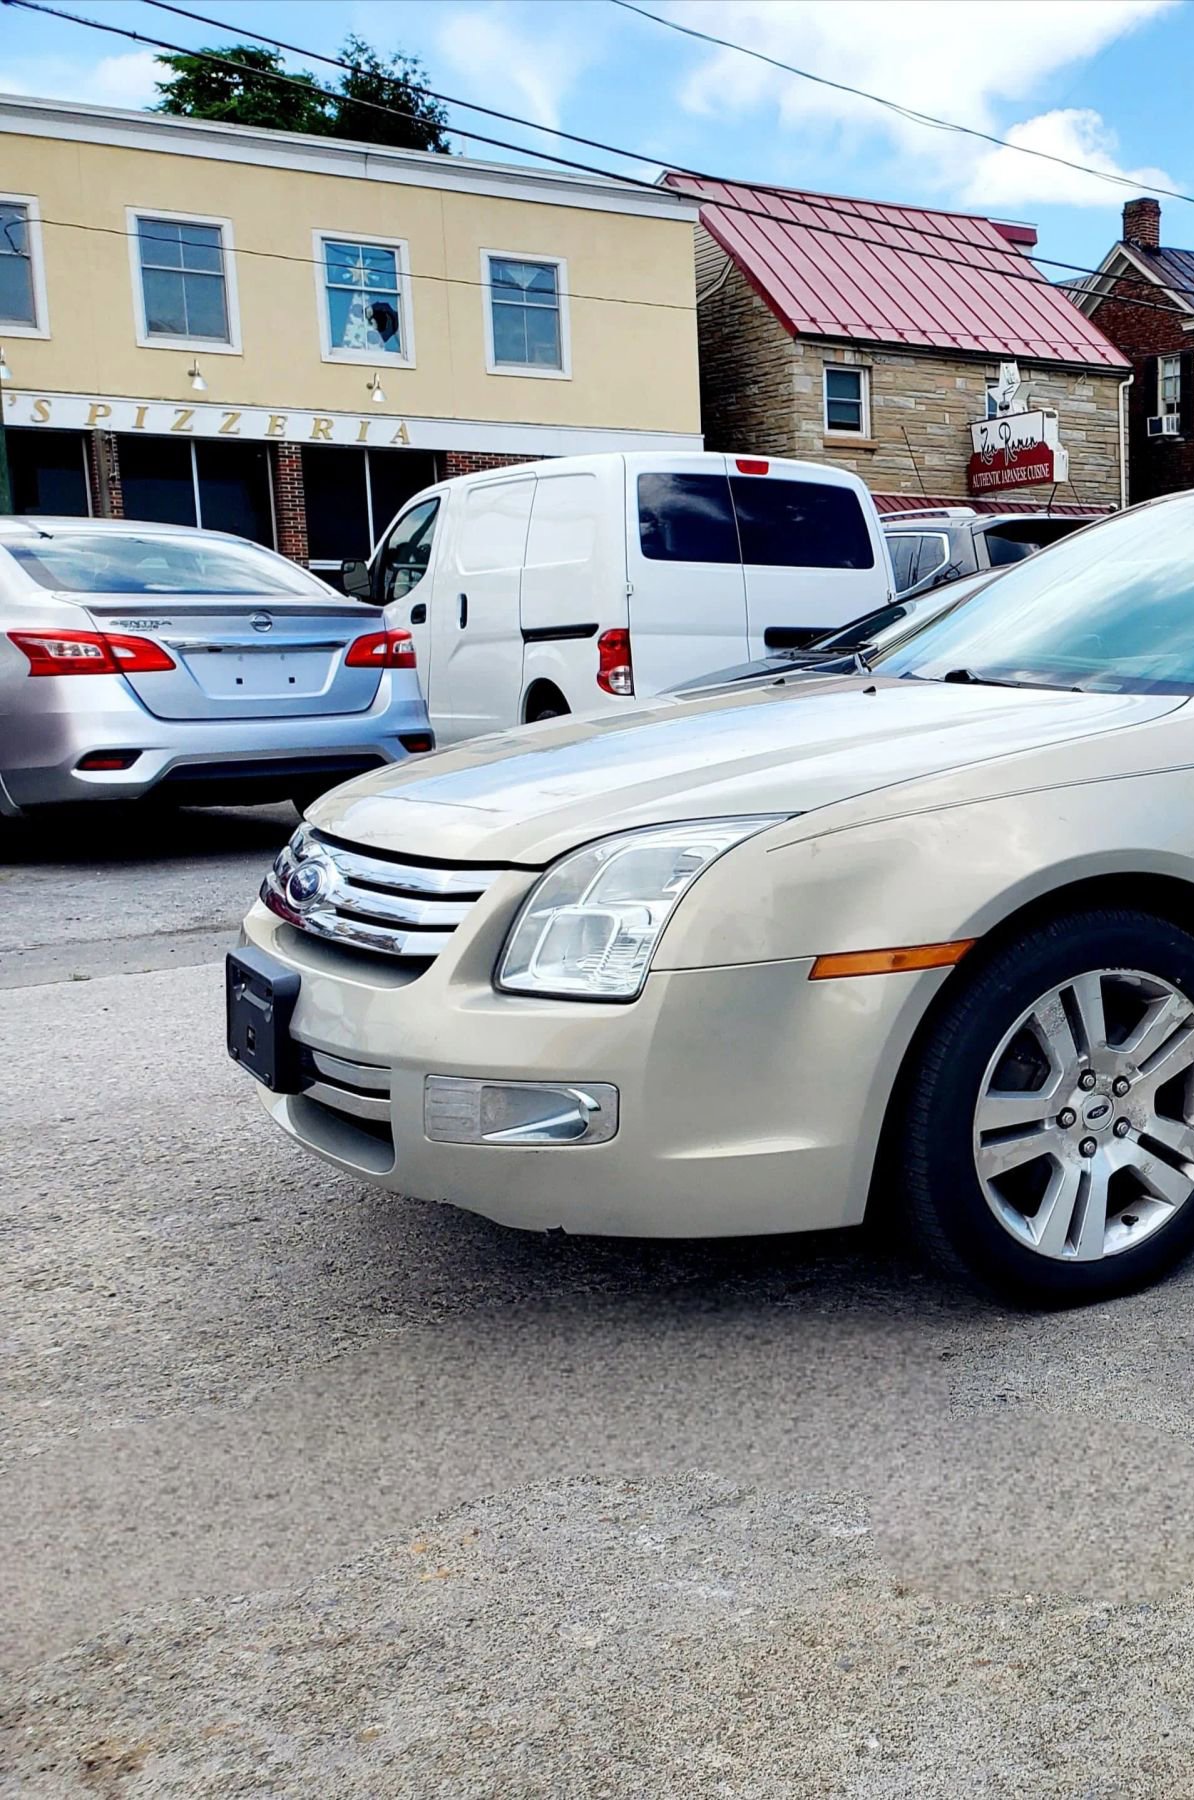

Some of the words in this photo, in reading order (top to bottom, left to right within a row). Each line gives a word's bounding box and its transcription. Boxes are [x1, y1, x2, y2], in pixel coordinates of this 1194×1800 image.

[84, 402, 411, 445] PIZZERIA
[999, 422, 1037, 466] Ramen
[973, 471, 1000, 488] AUTHENTIC
[1001, 466, 1027, 484] JAPANESE
[1027, 463, 1050, 480] CUISINE
